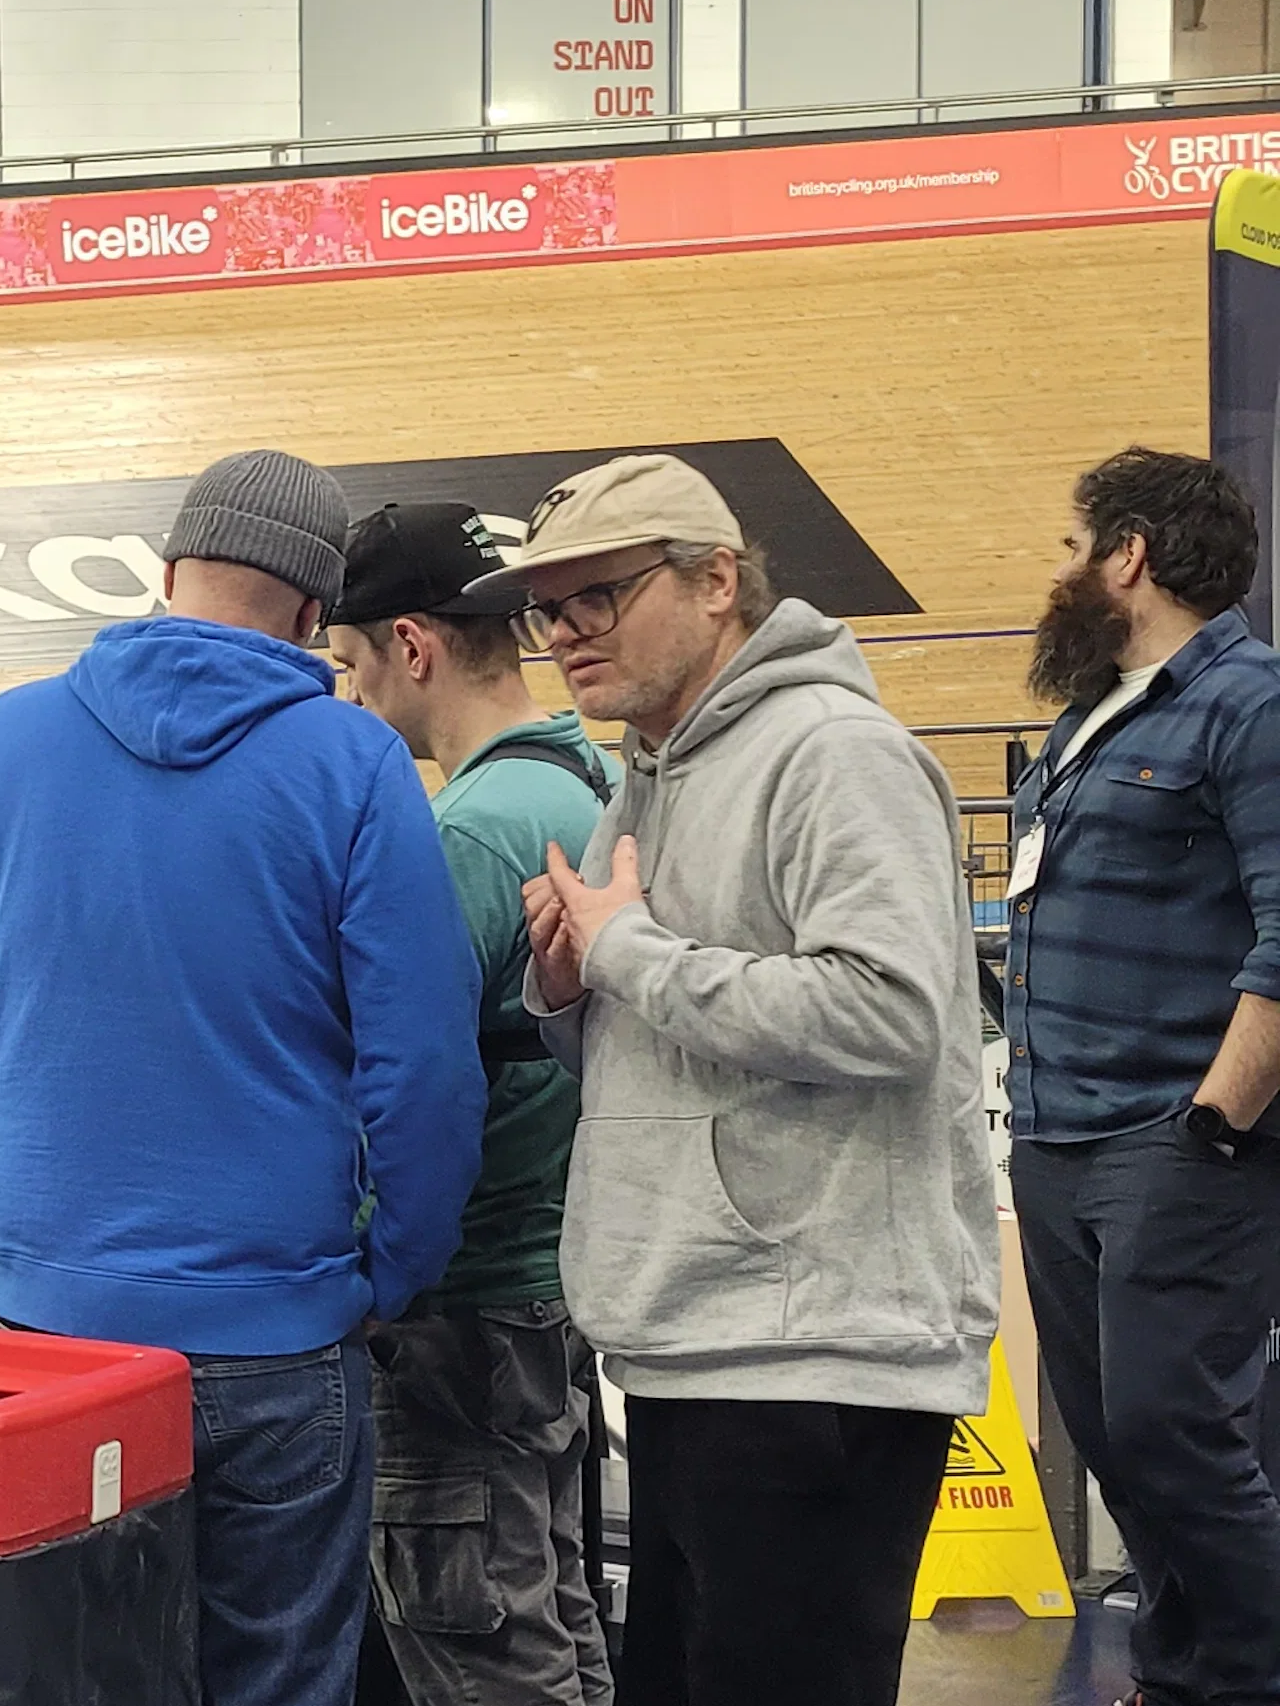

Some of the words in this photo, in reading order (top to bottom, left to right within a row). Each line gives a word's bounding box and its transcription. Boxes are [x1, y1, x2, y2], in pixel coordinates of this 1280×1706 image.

[553, 40, 654, 71] STAND
[594, 86, 654, 117] OUT
[789, 168, 999, 196] britishcycling.org.uk/membership
[948, 1485, 1014, 1509] FLOOR
